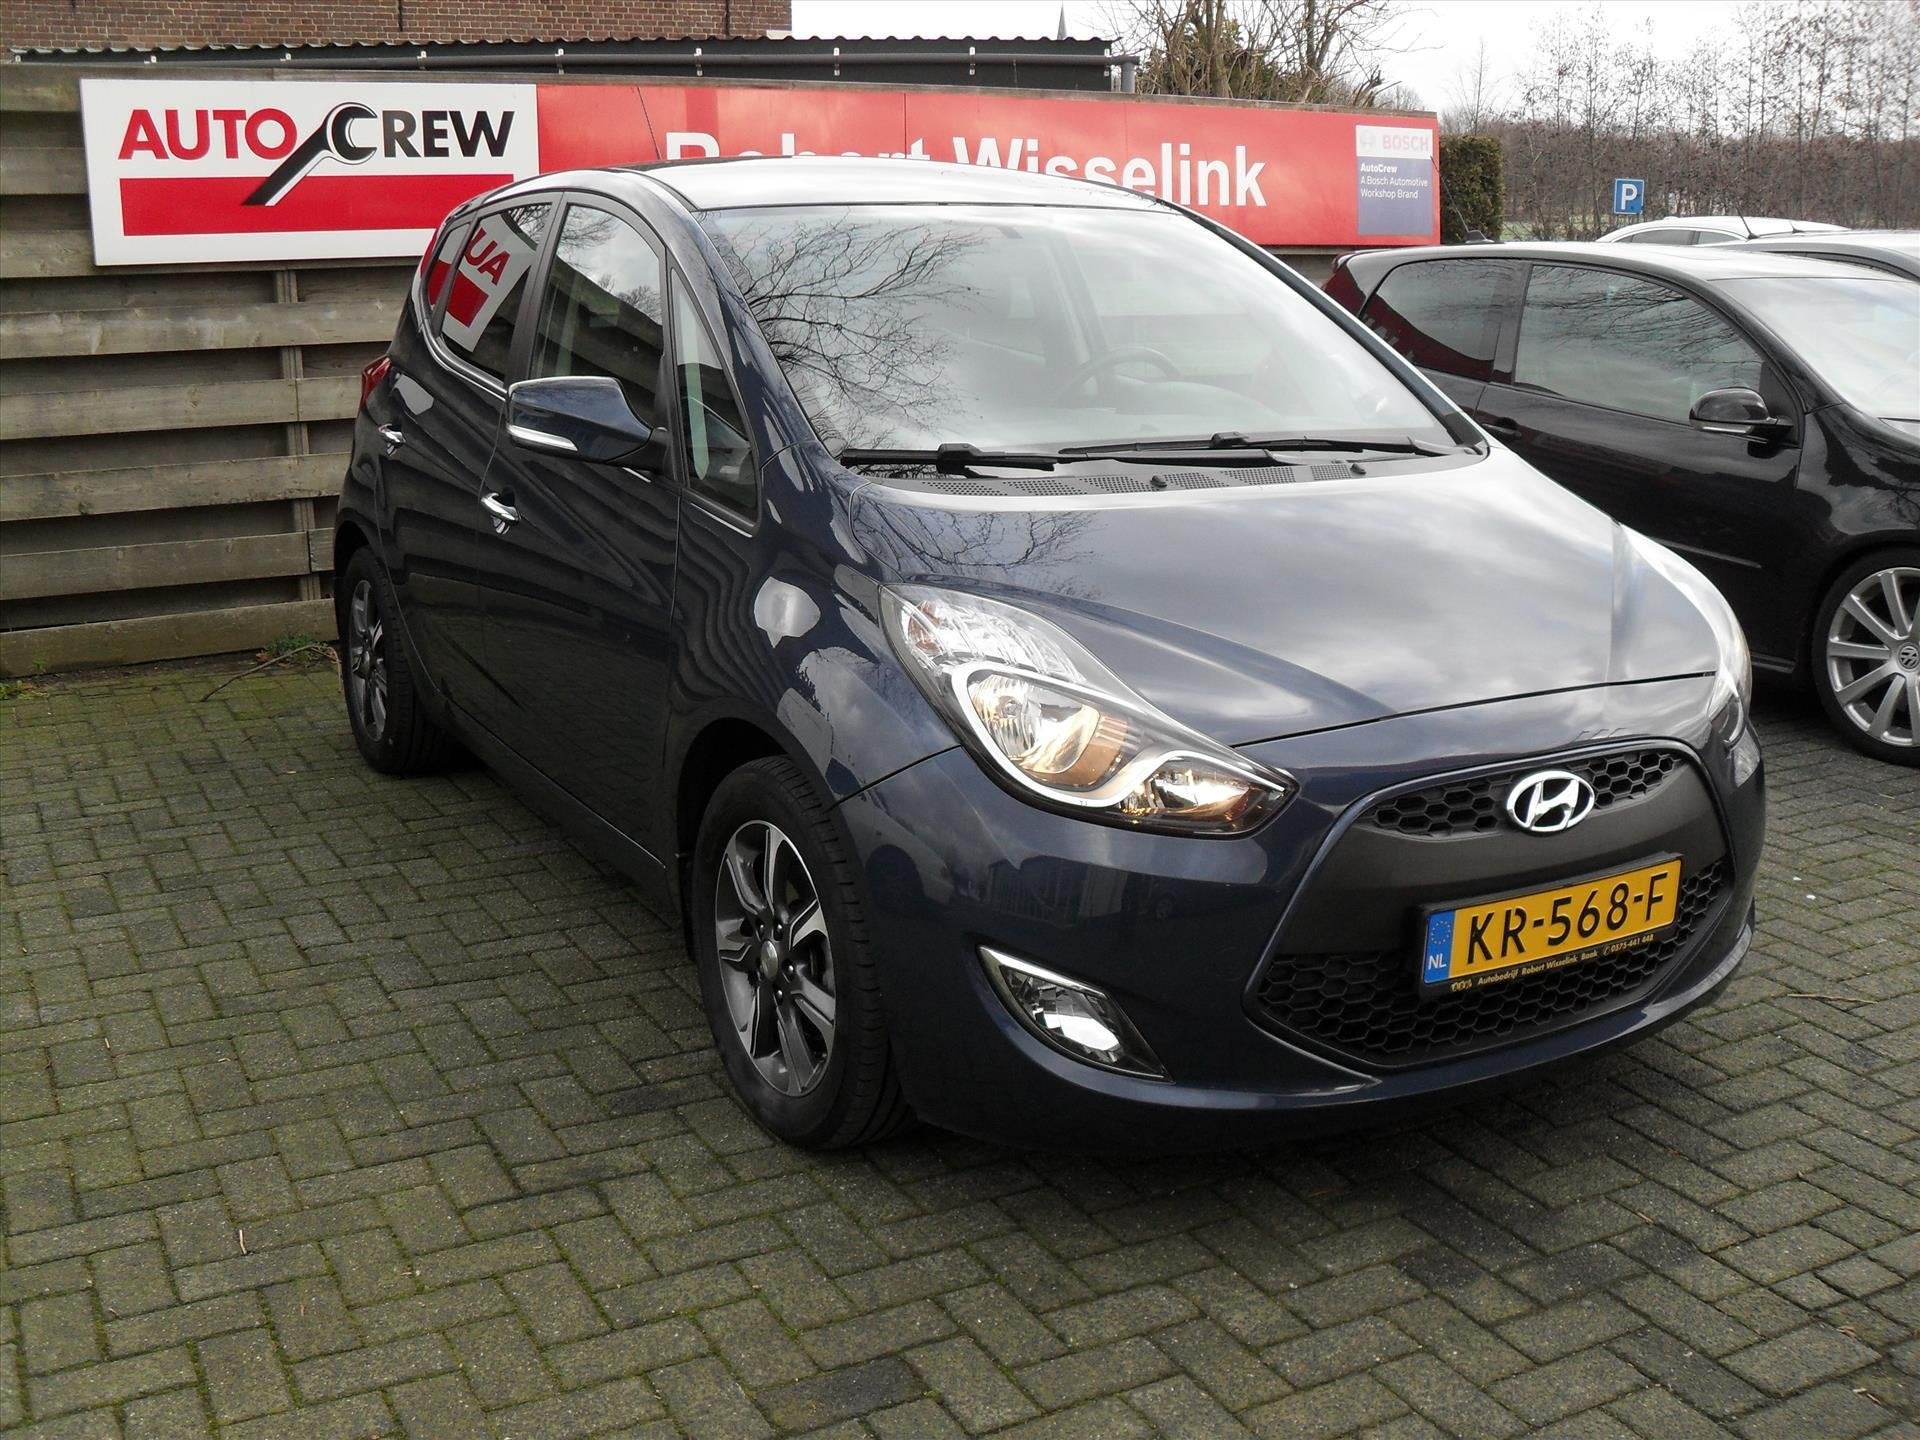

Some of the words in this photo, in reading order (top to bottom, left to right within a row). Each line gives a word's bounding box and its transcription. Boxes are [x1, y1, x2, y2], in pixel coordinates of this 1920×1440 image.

[118, 108, 298, 160] AUTO
[331, 105, 515, 162] CREW
[1382, 134, 1429, 151] BOSCH
[1360, 163, 1398, 174] AutoCrew
[1367, 176, 1389, 186] Bosch
[1389, 177, 1429, 187] Automotive
[1360, 188, 1396, 199] Workshop
[1397, 189, 1419, 199] Brand
[1621, 184, 1638, 210] P
[1467, 872, 1668, 965] KR-568-F
[1428, 952, 1447, 971] NL
